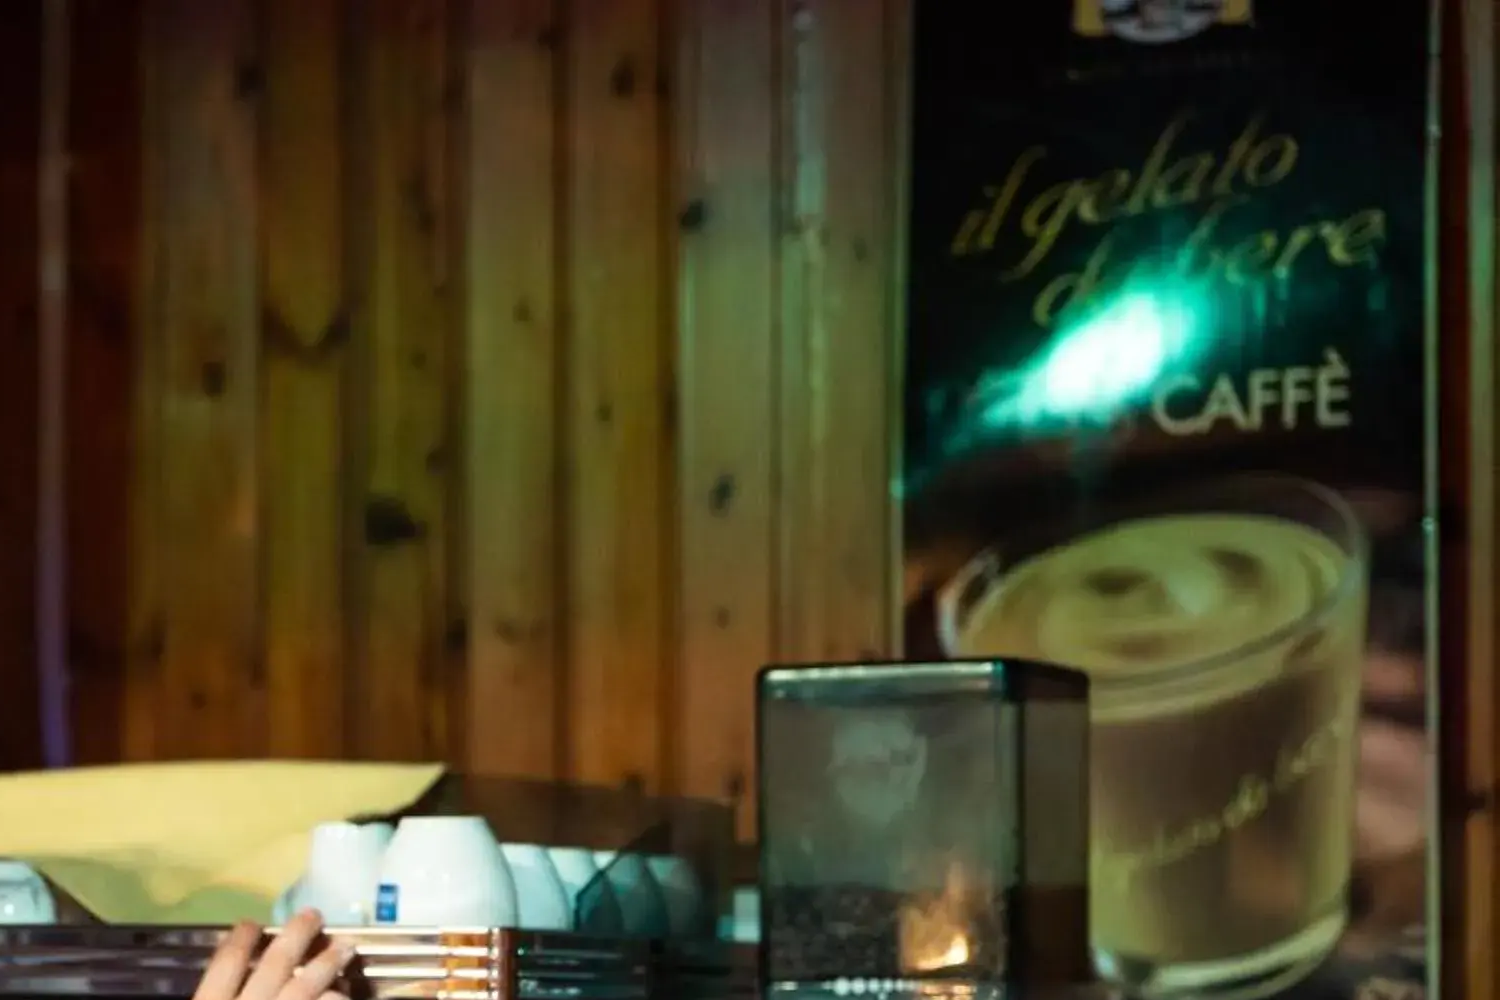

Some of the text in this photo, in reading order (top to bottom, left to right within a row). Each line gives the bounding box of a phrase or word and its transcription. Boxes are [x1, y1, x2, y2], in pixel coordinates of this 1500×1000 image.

[950, 106, 1299, 283] il gelato
[1150, 346, 1352, 437] CAFFÈ
